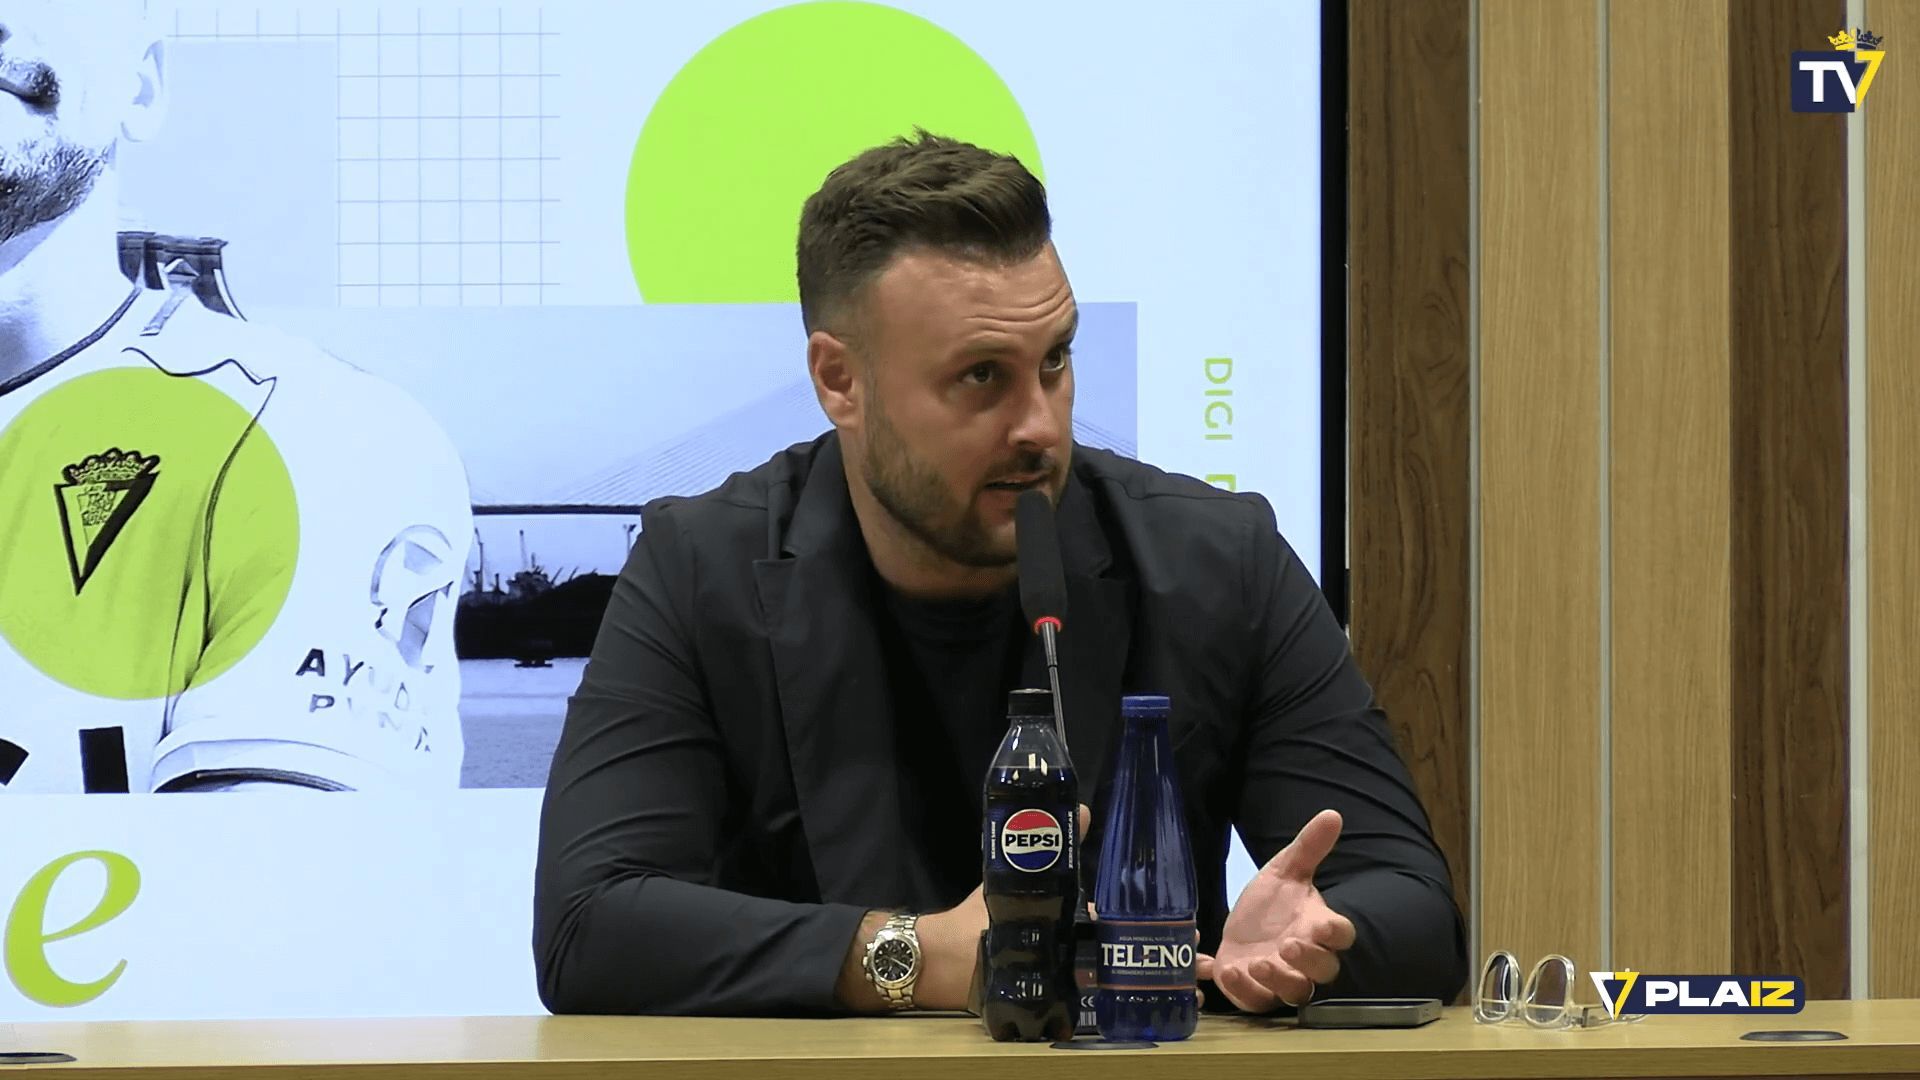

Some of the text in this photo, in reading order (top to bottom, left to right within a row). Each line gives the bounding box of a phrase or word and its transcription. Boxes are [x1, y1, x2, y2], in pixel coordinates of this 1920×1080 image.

[1204, 357, 1233, 440] DIGI
[1005, 833, 1060, 847] PEPSI
[1101, 943, 1193, 968] TELENO
